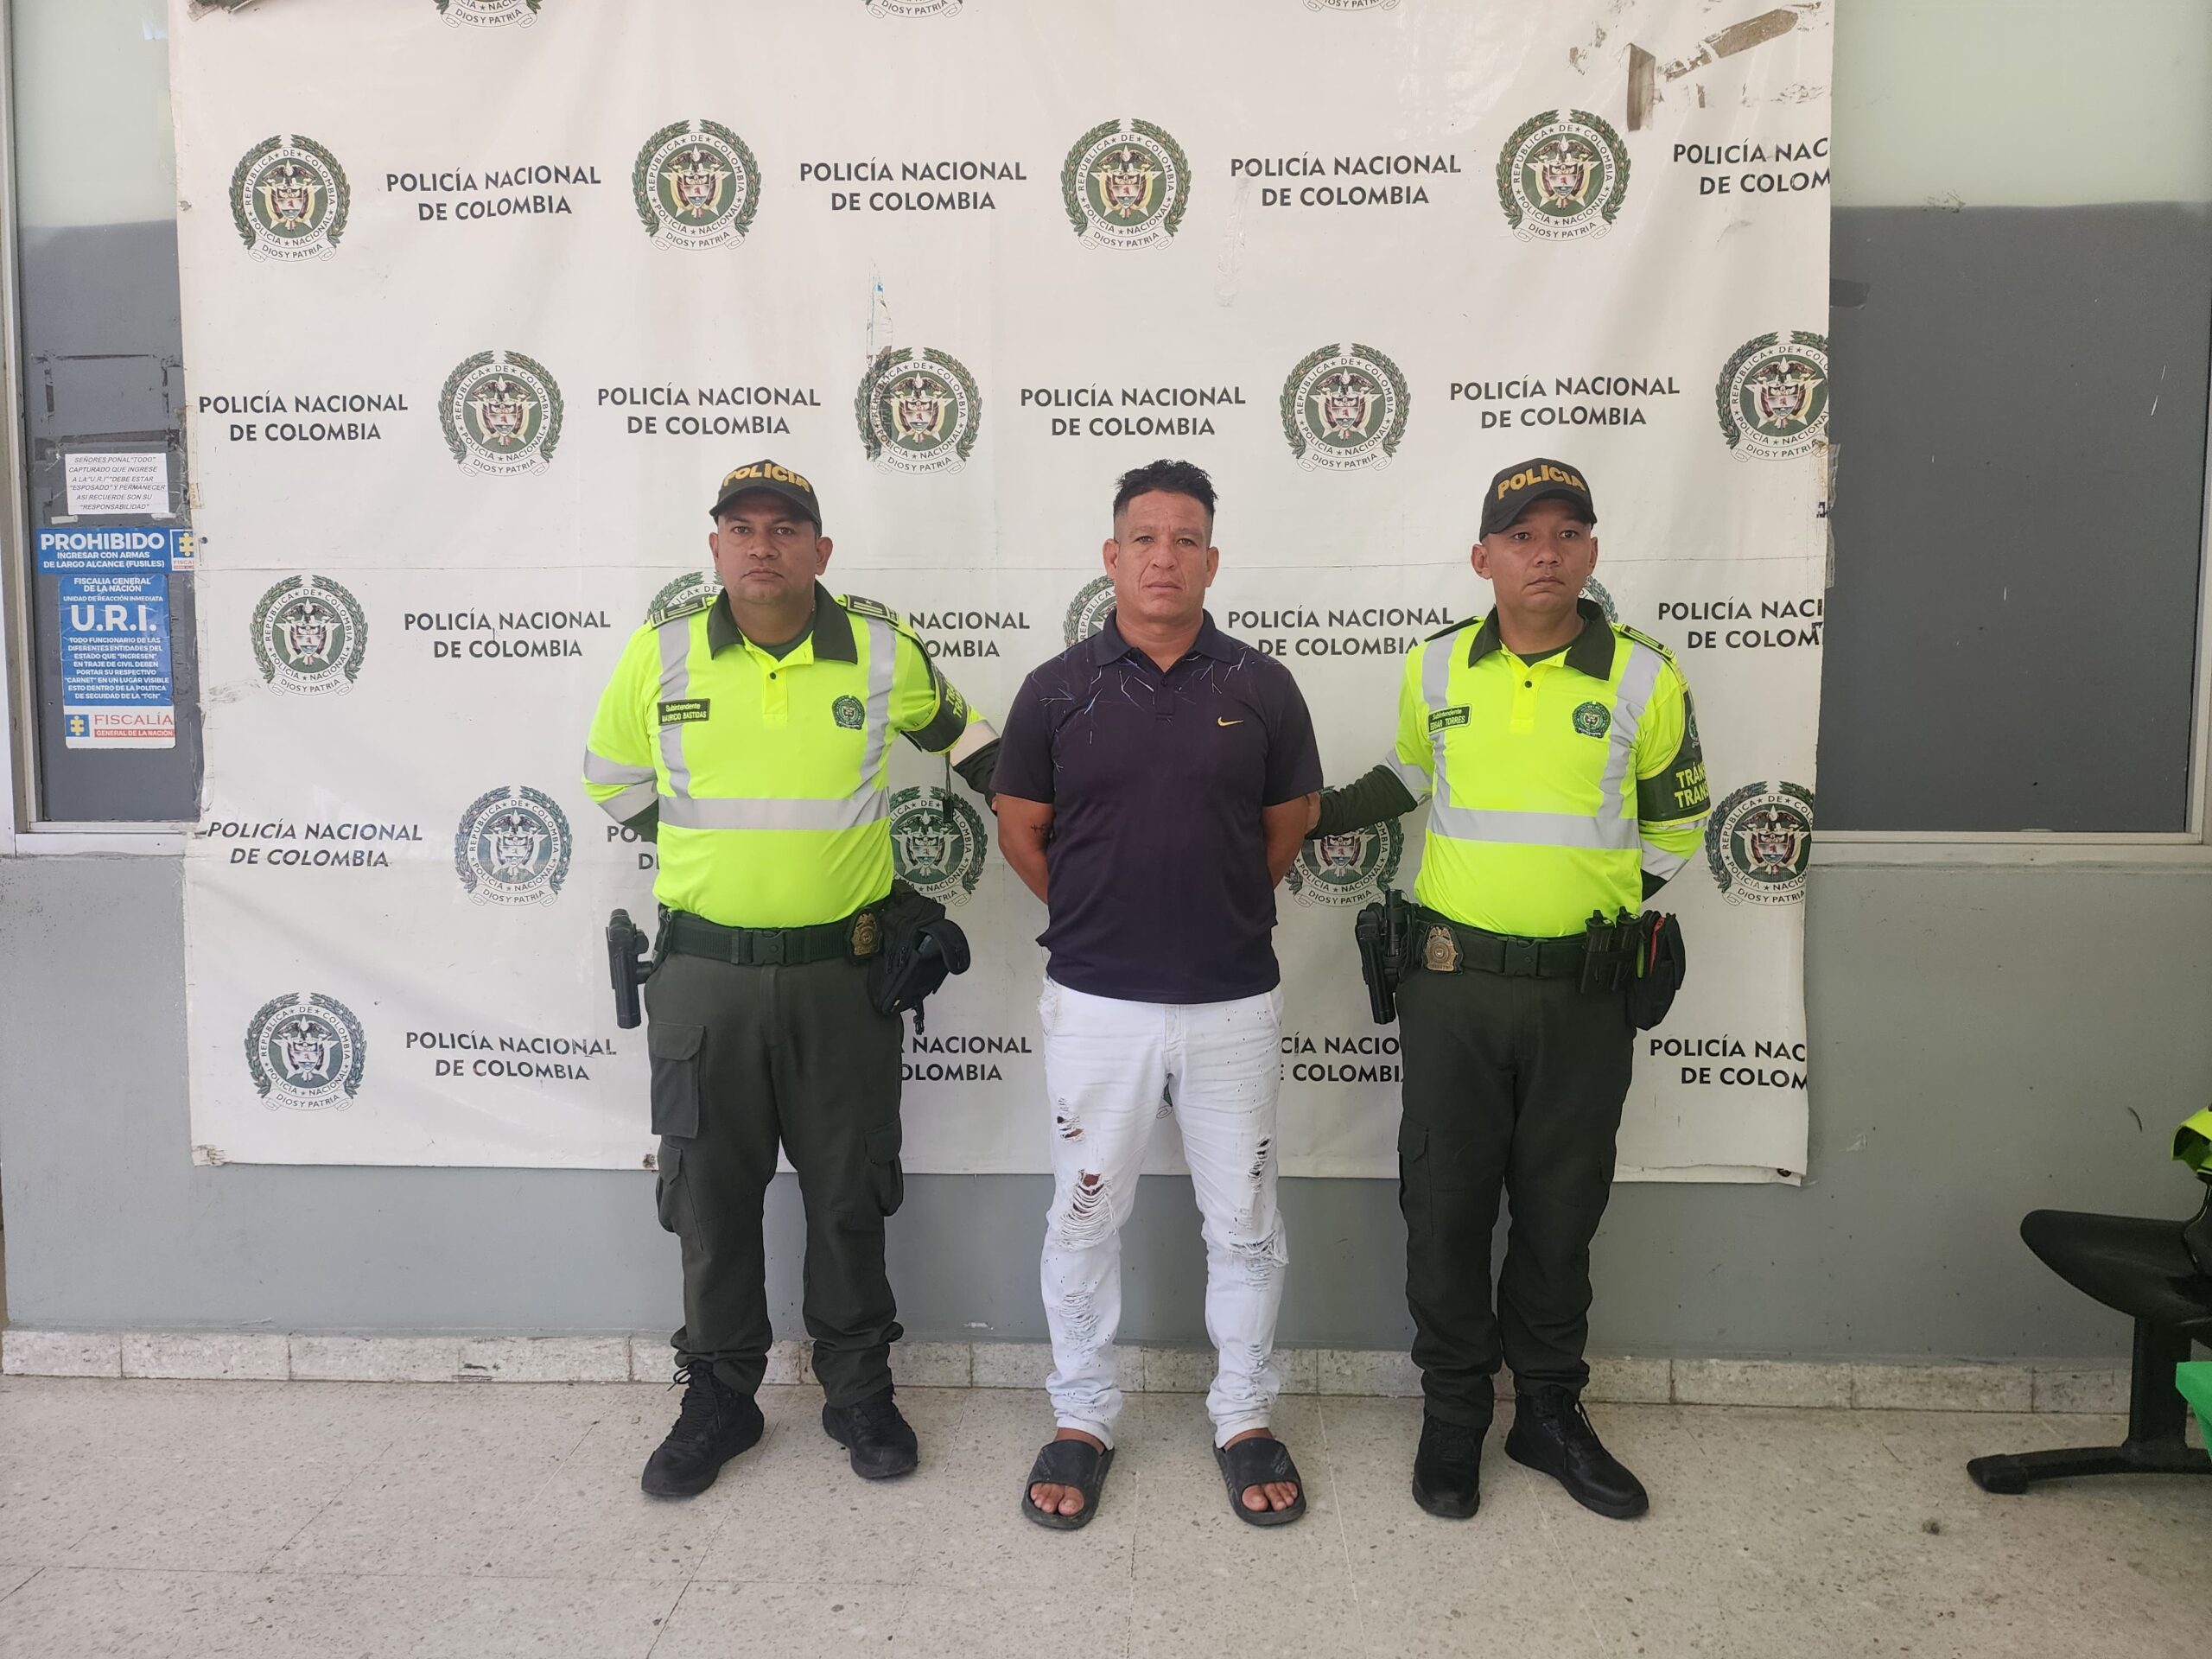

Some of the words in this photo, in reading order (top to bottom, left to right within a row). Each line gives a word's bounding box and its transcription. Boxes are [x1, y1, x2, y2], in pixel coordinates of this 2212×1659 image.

[1674, 139, 1766, 164] POLICÍA
[801, 158, 893, 181] POLICÍA
[902, 162, 1027, 181] NACIONAL
[1077, 140, 1112, 191] REPÚBLICA
[1145, 140, 1174, 192] COLOMBIA
[1231, 153, 1325, 176] POLICÍA
[1334, 155, 1460, 175] NACIONAL
[387, 168, 477, 191] POLICÍA
[486, 166, 601, 189] NACIONAL
[1700, 176, 1730, 194] DE
[1741, 168, 1830, 193] COLOM
[832, 193, 860, 210] DE
[870, 192, 995, 211] COLOMBIA
[1262, 188, 1291, 206] DE
[1300, 187, 1428, 206] COLOMBIA
[419, 203, 447, 220] DE
[455, 195, 572, 219] COLOMBIA
[1093, 232, 1116, 246] DIOS
[1116, 238, 1123, 247] Y
[1126, 232, 1160, 247] PATRIA
[599, 383, 690, 405] POLICÍA
[699, 387, 820, 406] NACIONAL
[1021, 384, 1113, 406] POLICÍA
[1122, 387, 1245, 406] NACIONAL
[1451, 375, 1547, 400] POLICÍA
[1556, 377, 1680, 396] NACIONAL
[200, 391, 287, 414] POLICÍA
[296, 394, 408, 412] NACIONAL
[628, 416, 657, 434] DE
[666, 416, 790, 435] COLOMBIA
[1052, 418, 1080, 435] DE
[1090, 417, 1214, 435] COLOMBIA
[1482, 410, 1510, 429] DE
[1521, 406, 1646, 426] COLOMBIA
[231, 424, 257, 441] DE
[265, 423, 380, 441] COLOMBIA
[1497, 465, 1586, 500] POLICIA
[41, 532, 165, 550] PROHIBIDO
[108, 583, 142, 592] NACIÓN
[71, 604, 157, 632] U.R.I.
[404, 608, 492, 630] POLICÍA
[499, 611, 610, 629] NACIONAL
[1229, 606, 1319, 628] POLICÍA
[1329, 607, 1453, 626] NACIONAL
[1659, 597, 1751, 620] POLICÍA
[1762, 599, 1822, 618] NACI
[910, 612, 1030, 629] NACIONAL
[435, 641, 461, 658] DE
[469, 639, 582, 658] COLOMBIA
[925, 639, 1000, 657] OMBIA
[1258, 639, 1287, 656] DE
[1688, 632, 1716, 648] DE
[1726, 629, 1819, 648] COLOM
[94, 712, 173, 725] FISCALÍA
[683, 711, 707, 720] BASTIDAS
[1445, 715, 1465, 726] TORRES
[1676, 761, 1705, 788] TRÁN
[207, 817, 296, 839] POLICÍA
[305, 823, 422, 840] NACIONAL
[231, 849, 260, 864] DE
[267, 849, 388, 867] COLOMBIA
[407, 1027, 493, 1050] POLICÍA
[499, 1037, 616, 1055] NACIONAL
[913, 1037, 1032, 1053] NACIONAL
[1325, 1037, 1399, 1054] NACIO
[1650, 1033, 1745, 1057] POLICÍA
[435, 1060, 463, 1076] DE
[474, 1059, 589, 1080] COLOMBIA
[901, 1064, 1002, 1081] OLOMBIA
[1293, 1064, 1403, 1082] COLOMBI
[1681, 1067, 1710, 1084] DE
[1720, 1068, 1808, 1090] COLOM
